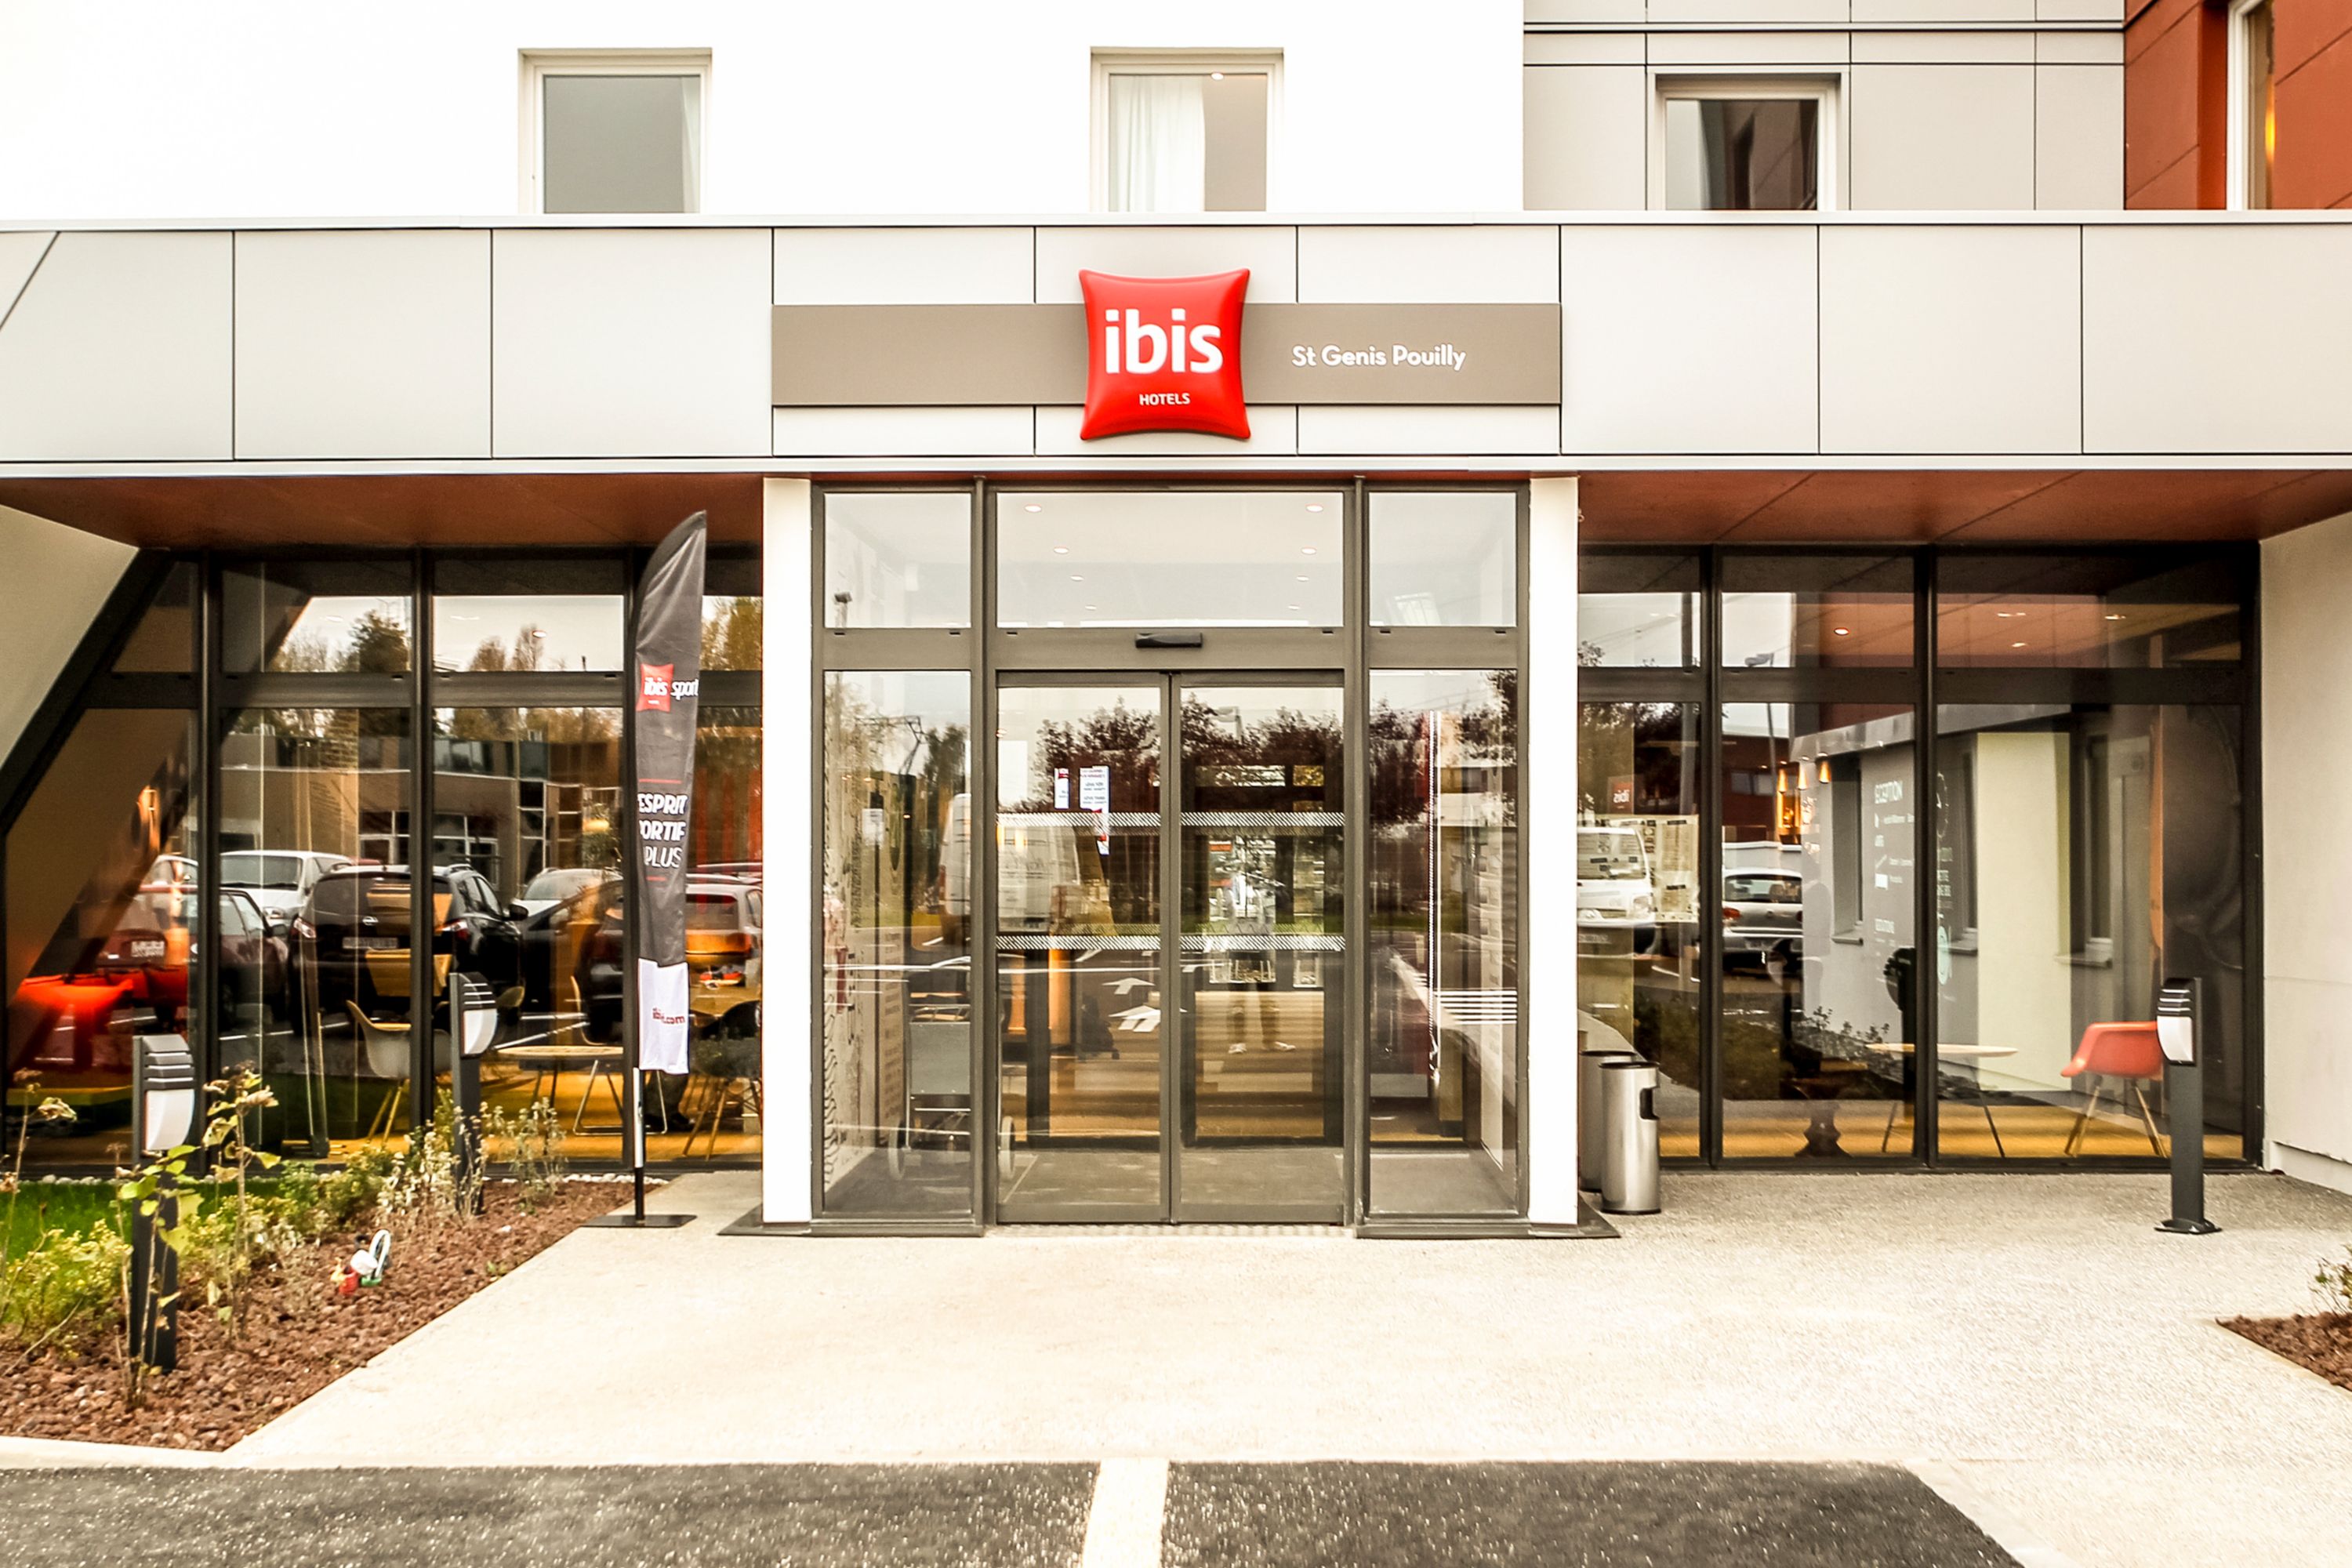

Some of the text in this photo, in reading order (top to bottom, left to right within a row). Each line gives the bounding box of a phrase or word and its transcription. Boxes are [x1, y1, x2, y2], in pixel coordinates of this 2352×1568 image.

[1105, 308, 1223, 374] ibis
[1291, 343, 1466, 371] St Genis Pouilly
[1138, 393, 1190, 406] HOTELS
[644, 677, 669, 696] ibis
[644, 846, 683, 868] PLUS
